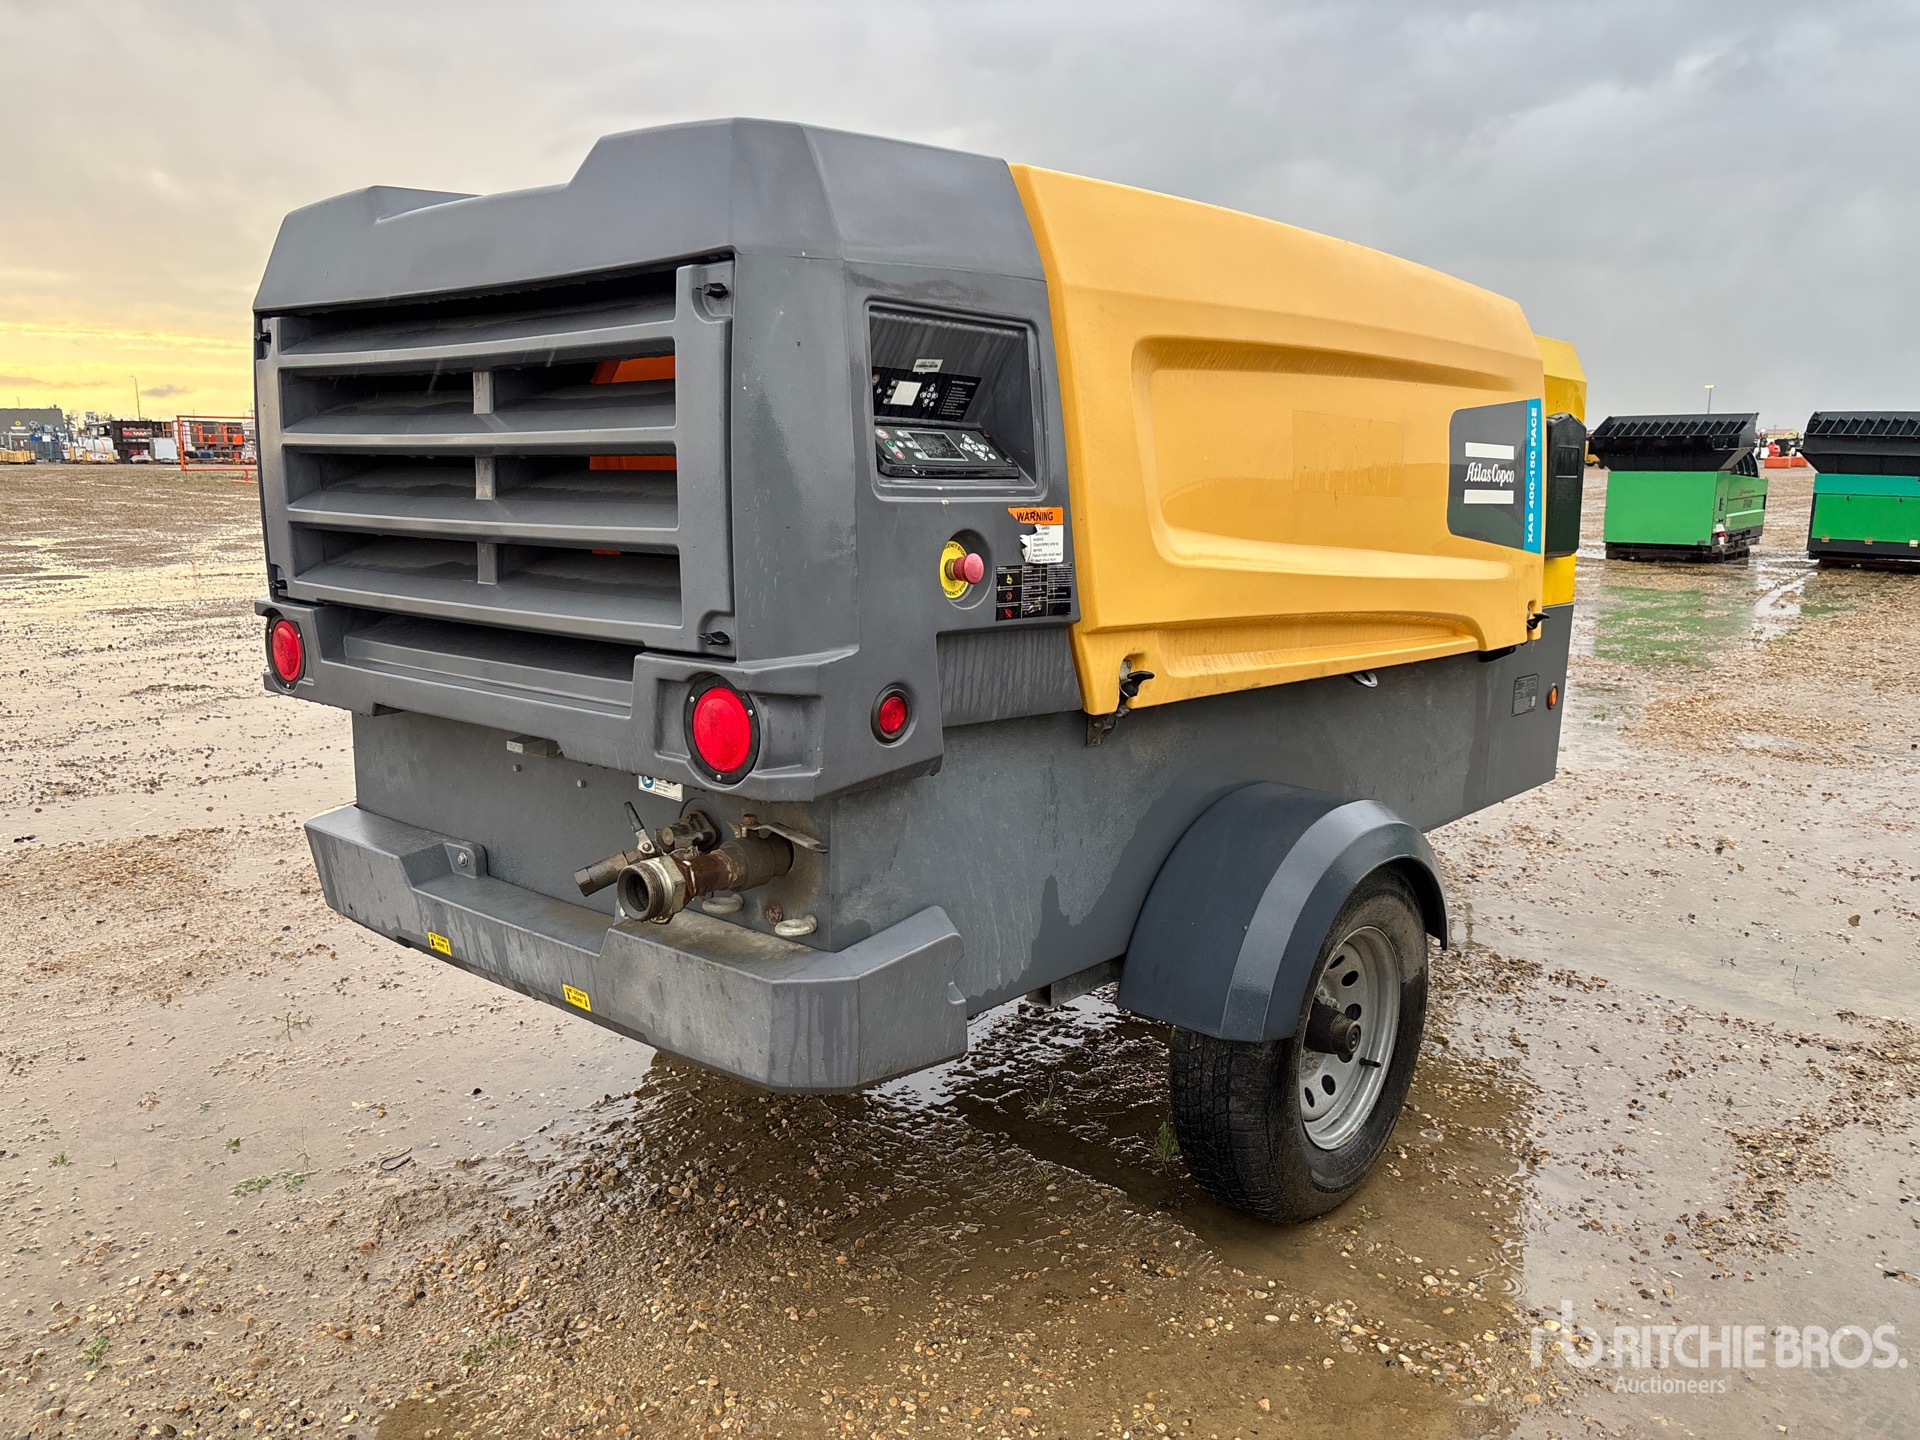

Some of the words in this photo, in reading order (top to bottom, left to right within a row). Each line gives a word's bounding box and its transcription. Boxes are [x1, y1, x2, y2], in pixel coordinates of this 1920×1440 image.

[1464, 461, 1492, 483] Atlas
[1492, 463, 1515, 487] Copco
[1017, 511, 1054, 522] WARNING
